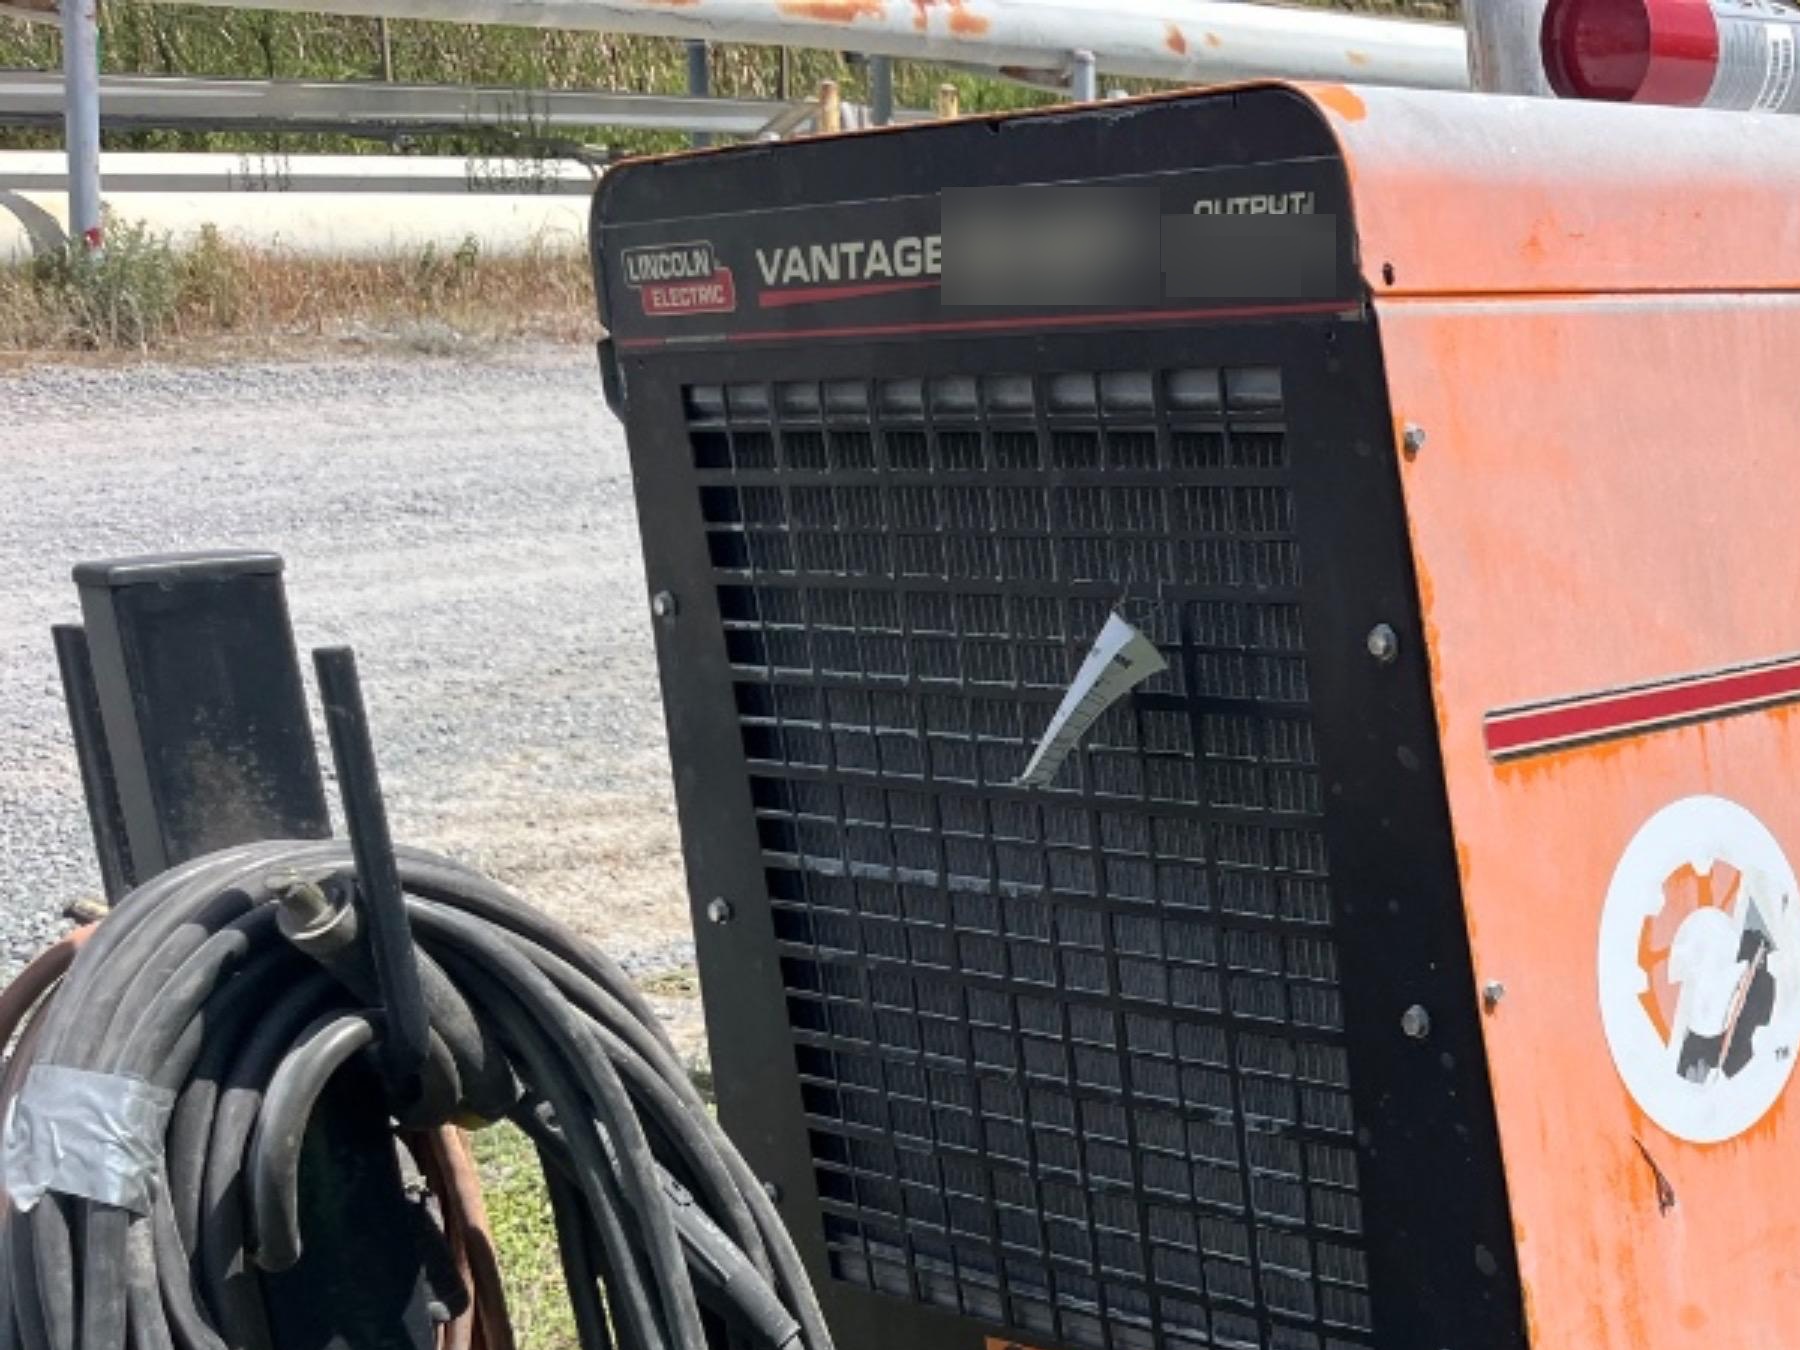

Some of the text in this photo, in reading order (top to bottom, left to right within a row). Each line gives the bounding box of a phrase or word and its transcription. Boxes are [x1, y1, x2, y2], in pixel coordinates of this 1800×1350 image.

[626, 248, 711, 280] LINCOLN
[756, 236, 941, 286] VANTAGE
[653, 284, 725, 308] ELECTRIC
